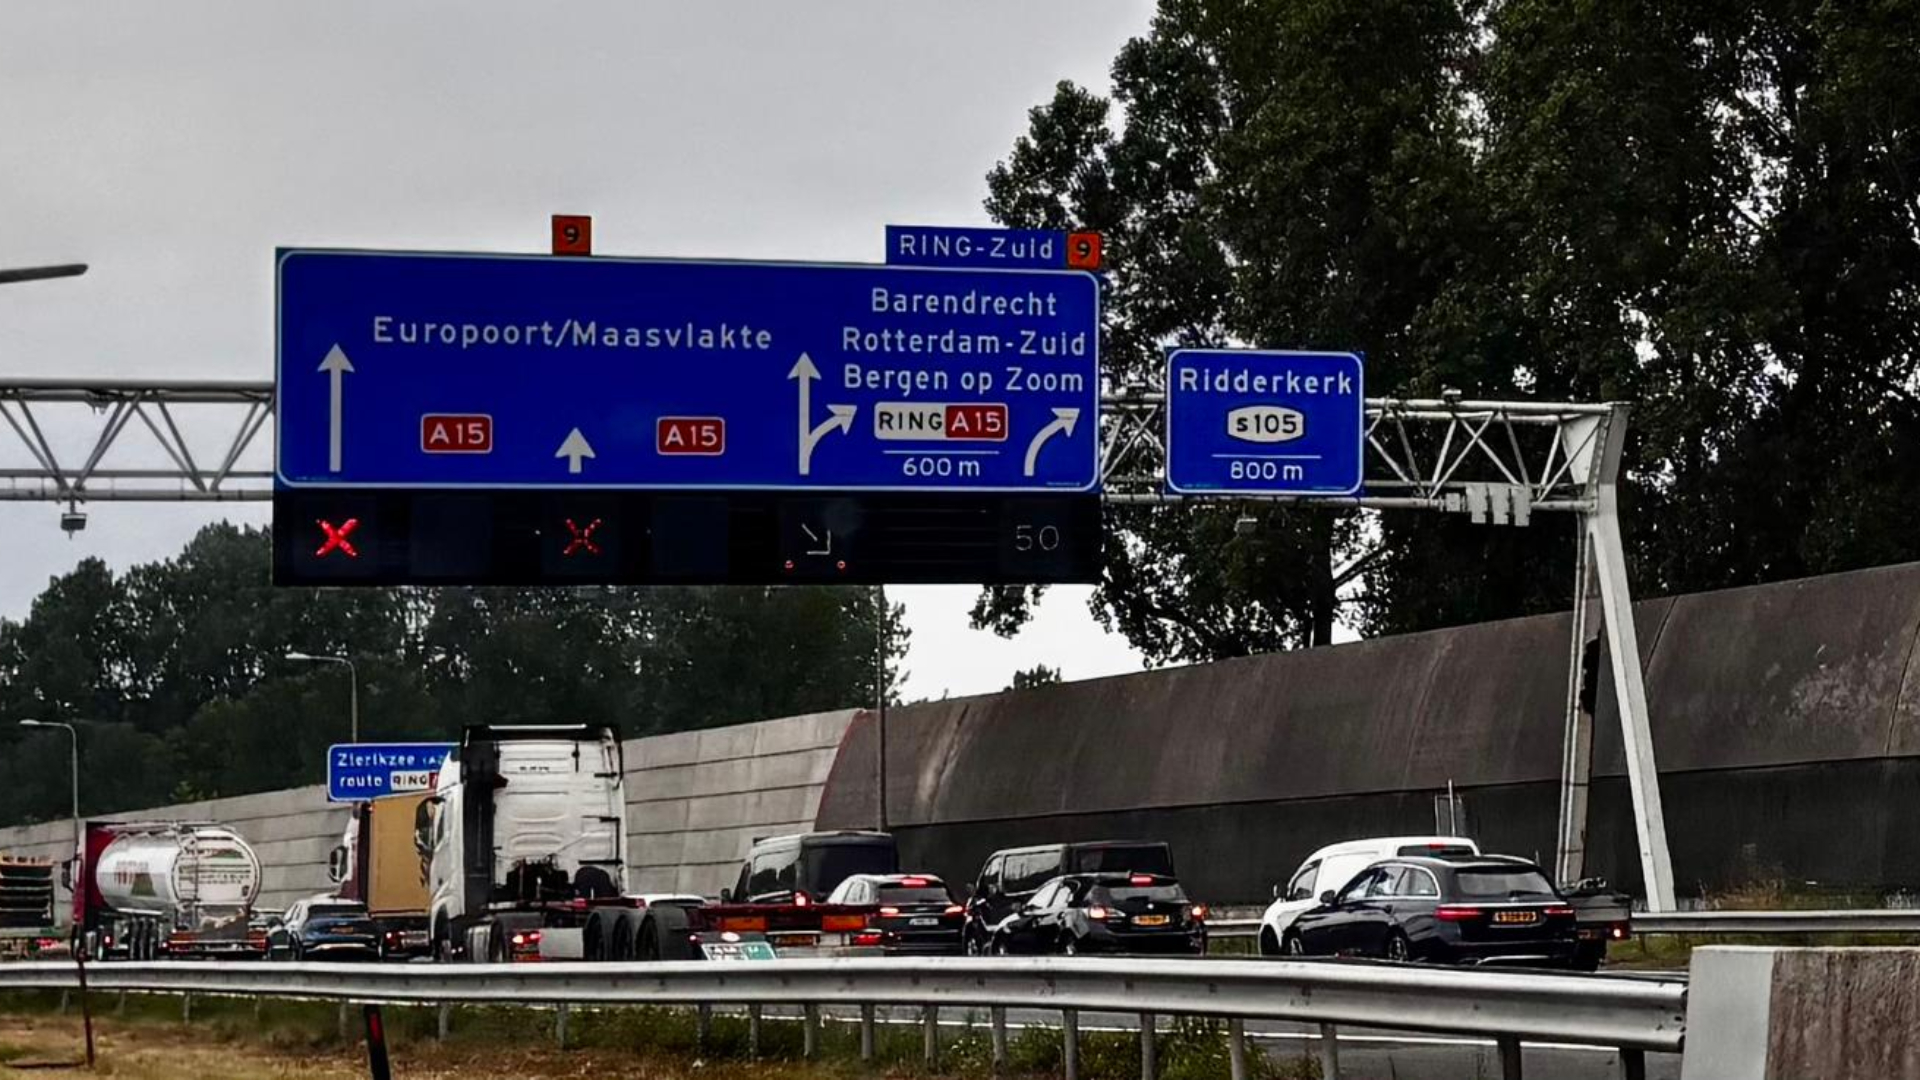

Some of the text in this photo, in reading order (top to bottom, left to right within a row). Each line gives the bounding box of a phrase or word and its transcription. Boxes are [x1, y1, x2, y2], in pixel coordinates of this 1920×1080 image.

[563, 225, 579, 244] 9
[900, 234, 1054, 260] RING-Zuid
[1076, 242, 1090, 259] 9
[871, 287, 1058, 317] Barendrecht
[374, 315, 774, 351] Europoort/Maasvlakte
[843, 326, 1086, 357] Rotterdam-Zuid
[844, 364, 1084, 397] Bergen op Zoom
[1179, 367, 1353, 395] Ridderkerk
[878, 410, 1002, 433] RING A15
[1235, 414, 1298, 435] s105
[429, 422, 485, 446] A15
[664, 424, 718, 448] A15
[903, 457, 980, 477] 600 m
[1230, 461, 1304, 481] 800 m
[1015, 525, 1060, 551] 50
[337, 752, 416, 768] Zierikzee
[339, 775, 383, 788] route
[392, 775, 429, 787] RING
